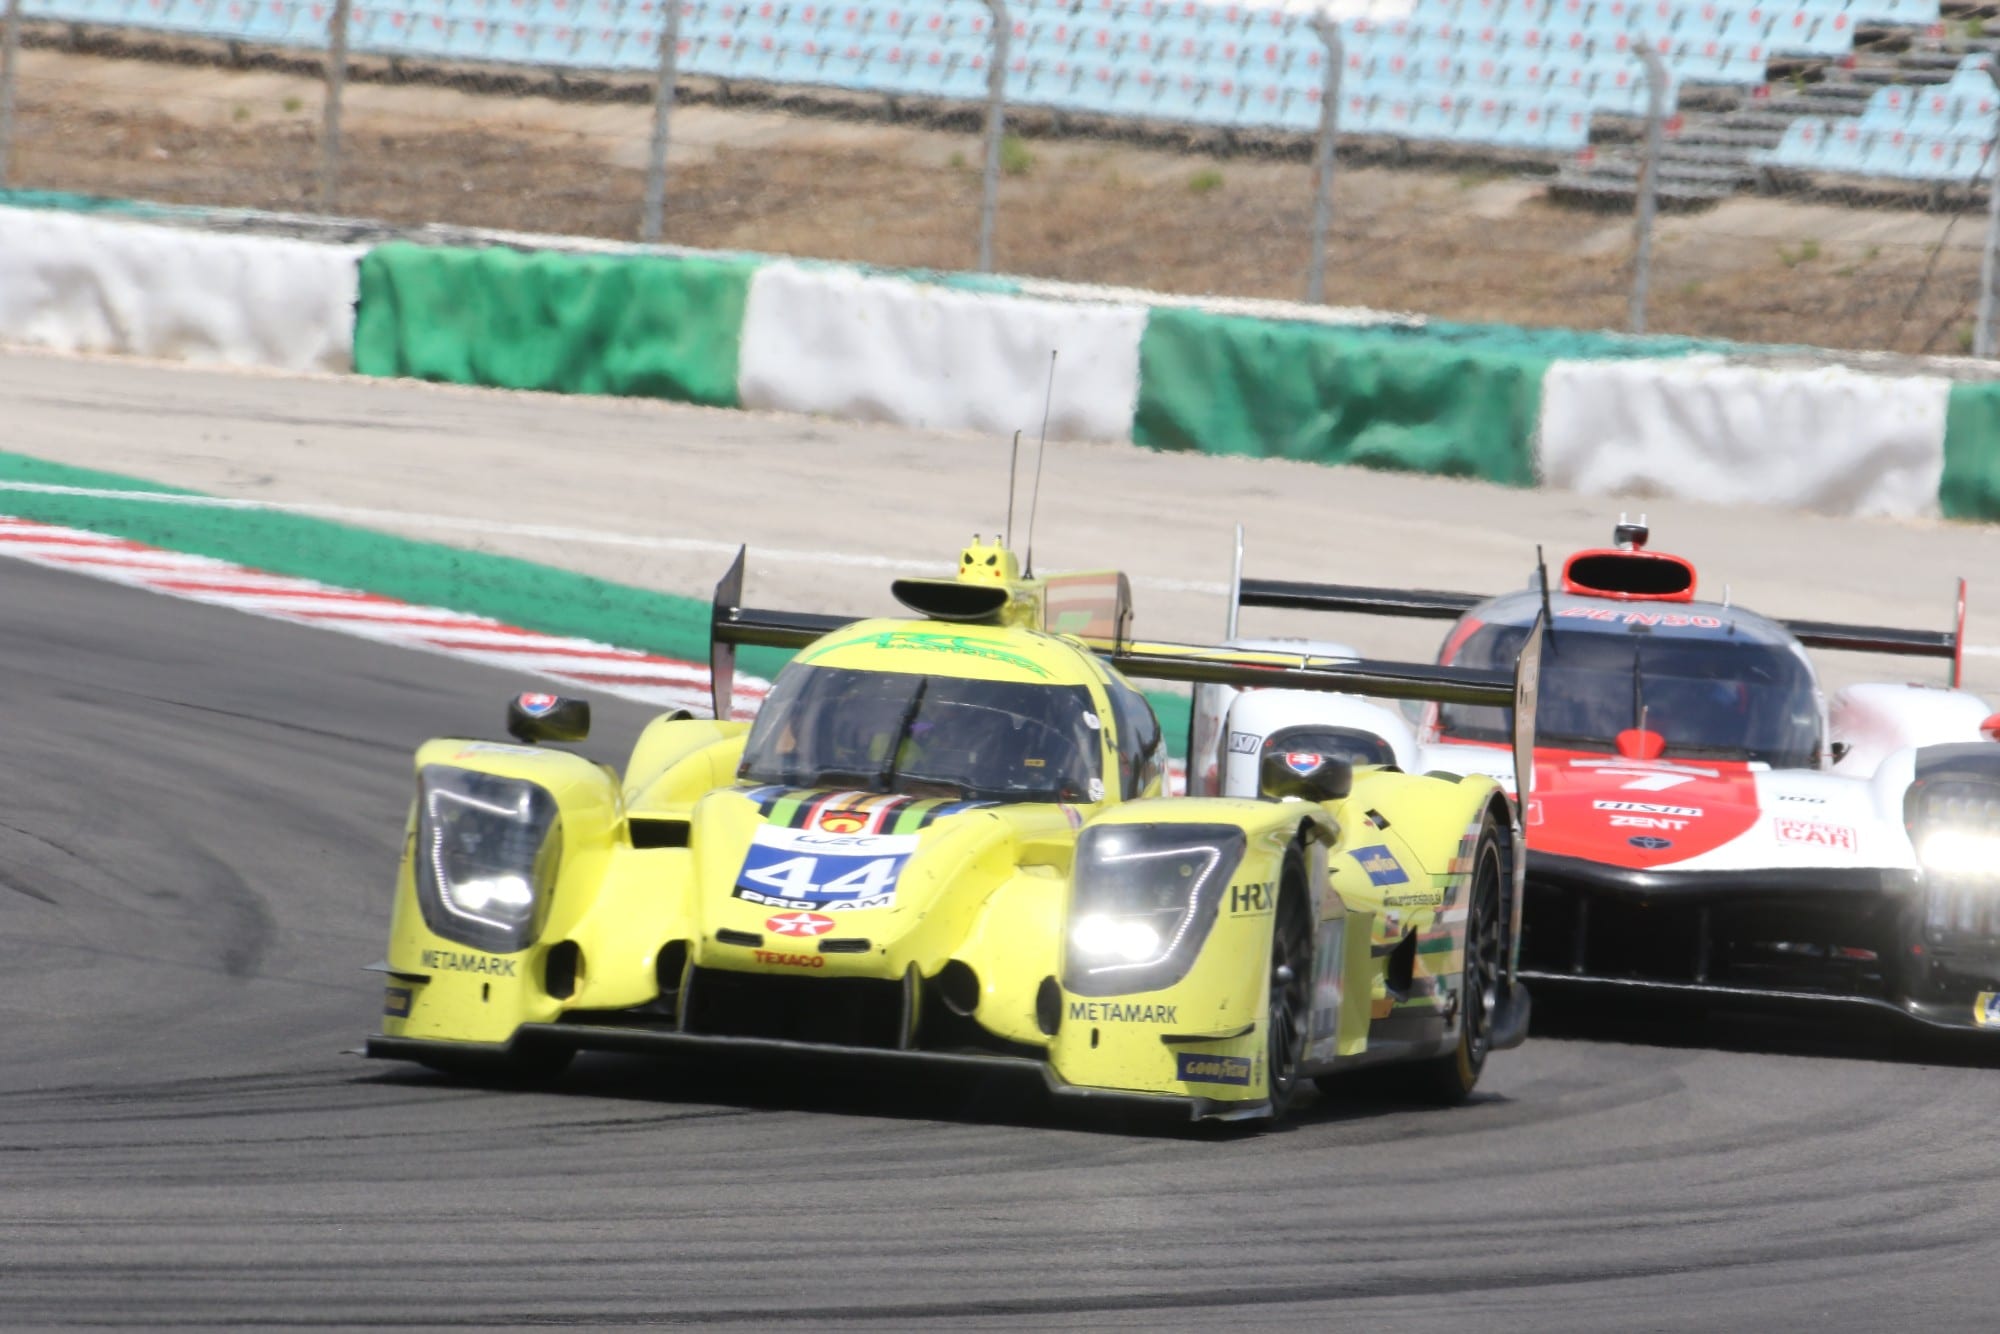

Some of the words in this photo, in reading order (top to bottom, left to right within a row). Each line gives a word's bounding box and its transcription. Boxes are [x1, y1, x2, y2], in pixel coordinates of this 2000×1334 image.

[1557, 607, 1721, 628] DENSO
[1595, 768, 1696, 791] 7
[1598, 802, 1698, 816] AISIN
[1610, 815, 1689, 830] ZENT
[795, 835, 880, 847] WEC
[1783, 827, 1850, 849] CAR
[744, 857, 896, 899] 44
[740, 890, 816, 910] PRO
[834, 896, 890, 910] AM
[1231, 882, 1275, 913] HRX
[422, 949, 517, 977] METAMARK
[755, 950, 824, 968] TEXACO
[1069, 1002, 1178, 1025] METAMARK
